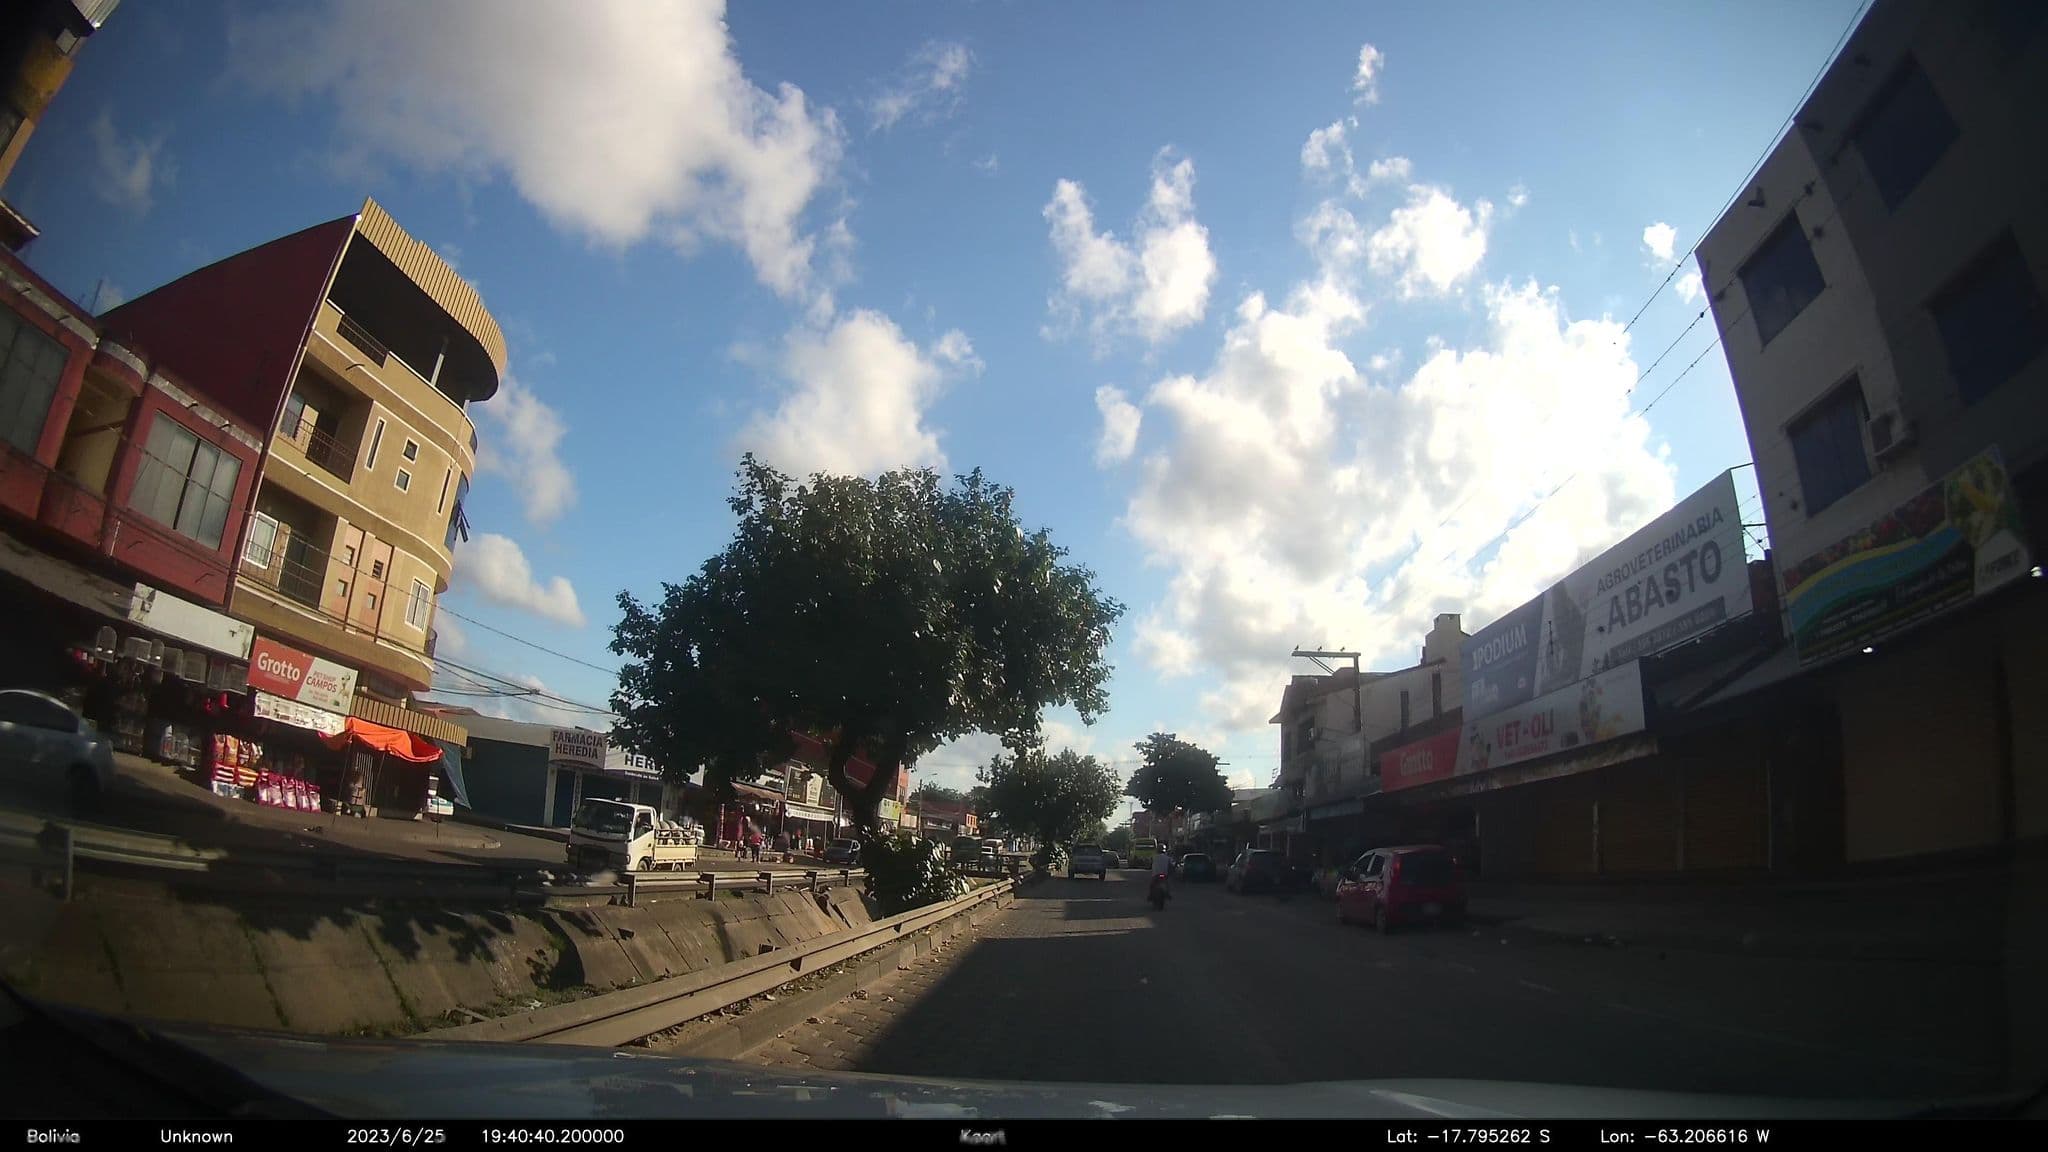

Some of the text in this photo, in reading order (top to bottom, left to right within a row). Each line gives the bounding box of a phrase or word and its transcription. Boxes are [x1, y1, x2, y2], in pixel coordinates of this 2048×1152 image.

[1597, 506, 1724, 596] AGROVETERINARIA
[1608, 540, 1722, 635] ABASTO
[257, 652, 301, 682] Grotto
[306, 676, 338, 693] CAMPOS
[552, 730, 603, 748] FARMACIA
[555, 743, 599, 759] HEREDIA
